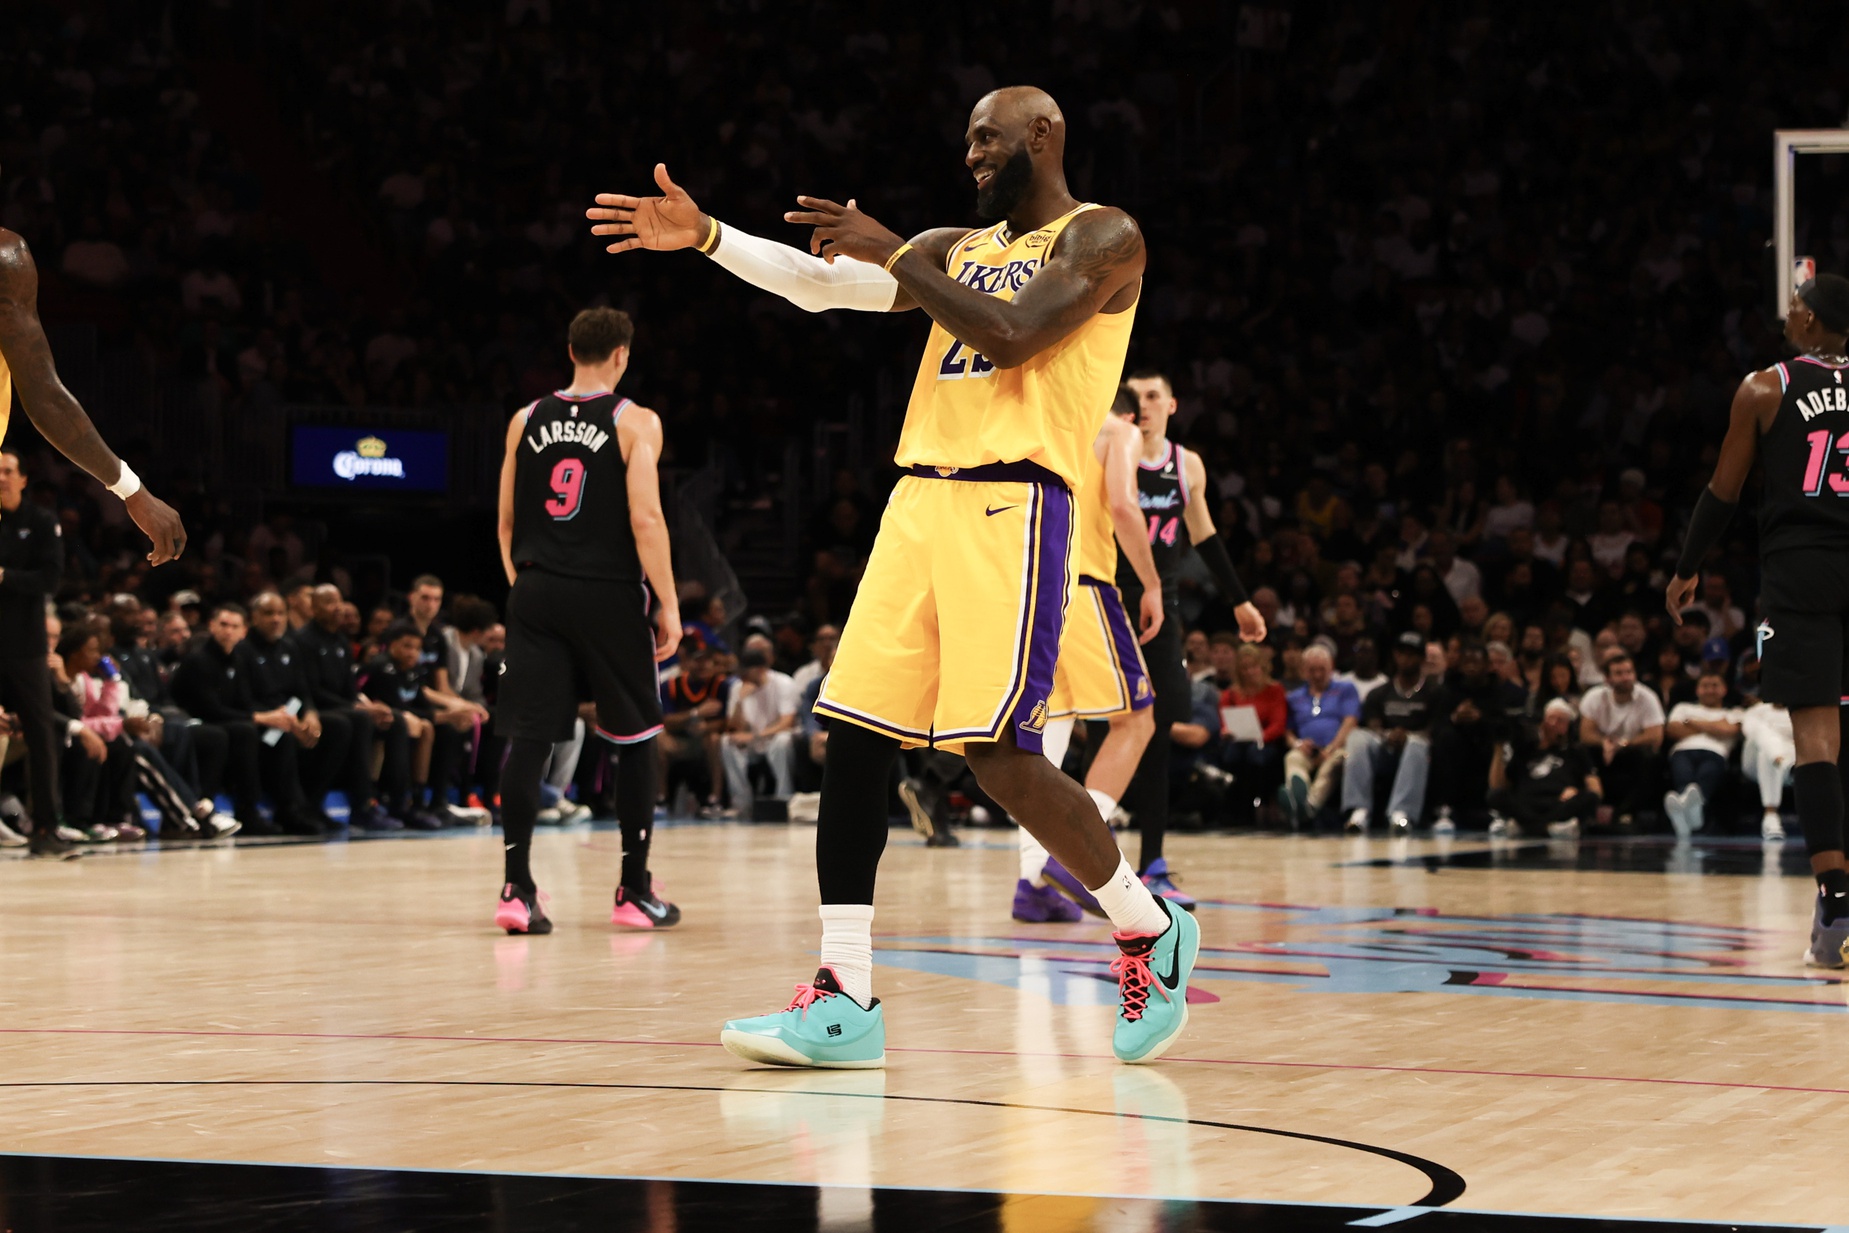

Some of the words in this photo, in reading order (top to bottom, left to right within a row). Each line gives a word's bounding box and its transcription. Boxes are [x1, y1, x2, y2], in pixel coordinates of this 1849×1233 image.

[955, 259, 1038, 293] LKERS
[1796, 387, 1849, 422] ADEB
[527, 420, 609, 454] LARSSON
[333, 450, 403, 481] Corona
[545, 458, 587, 521] 9
[1148, 515, 1180, 547] 14
